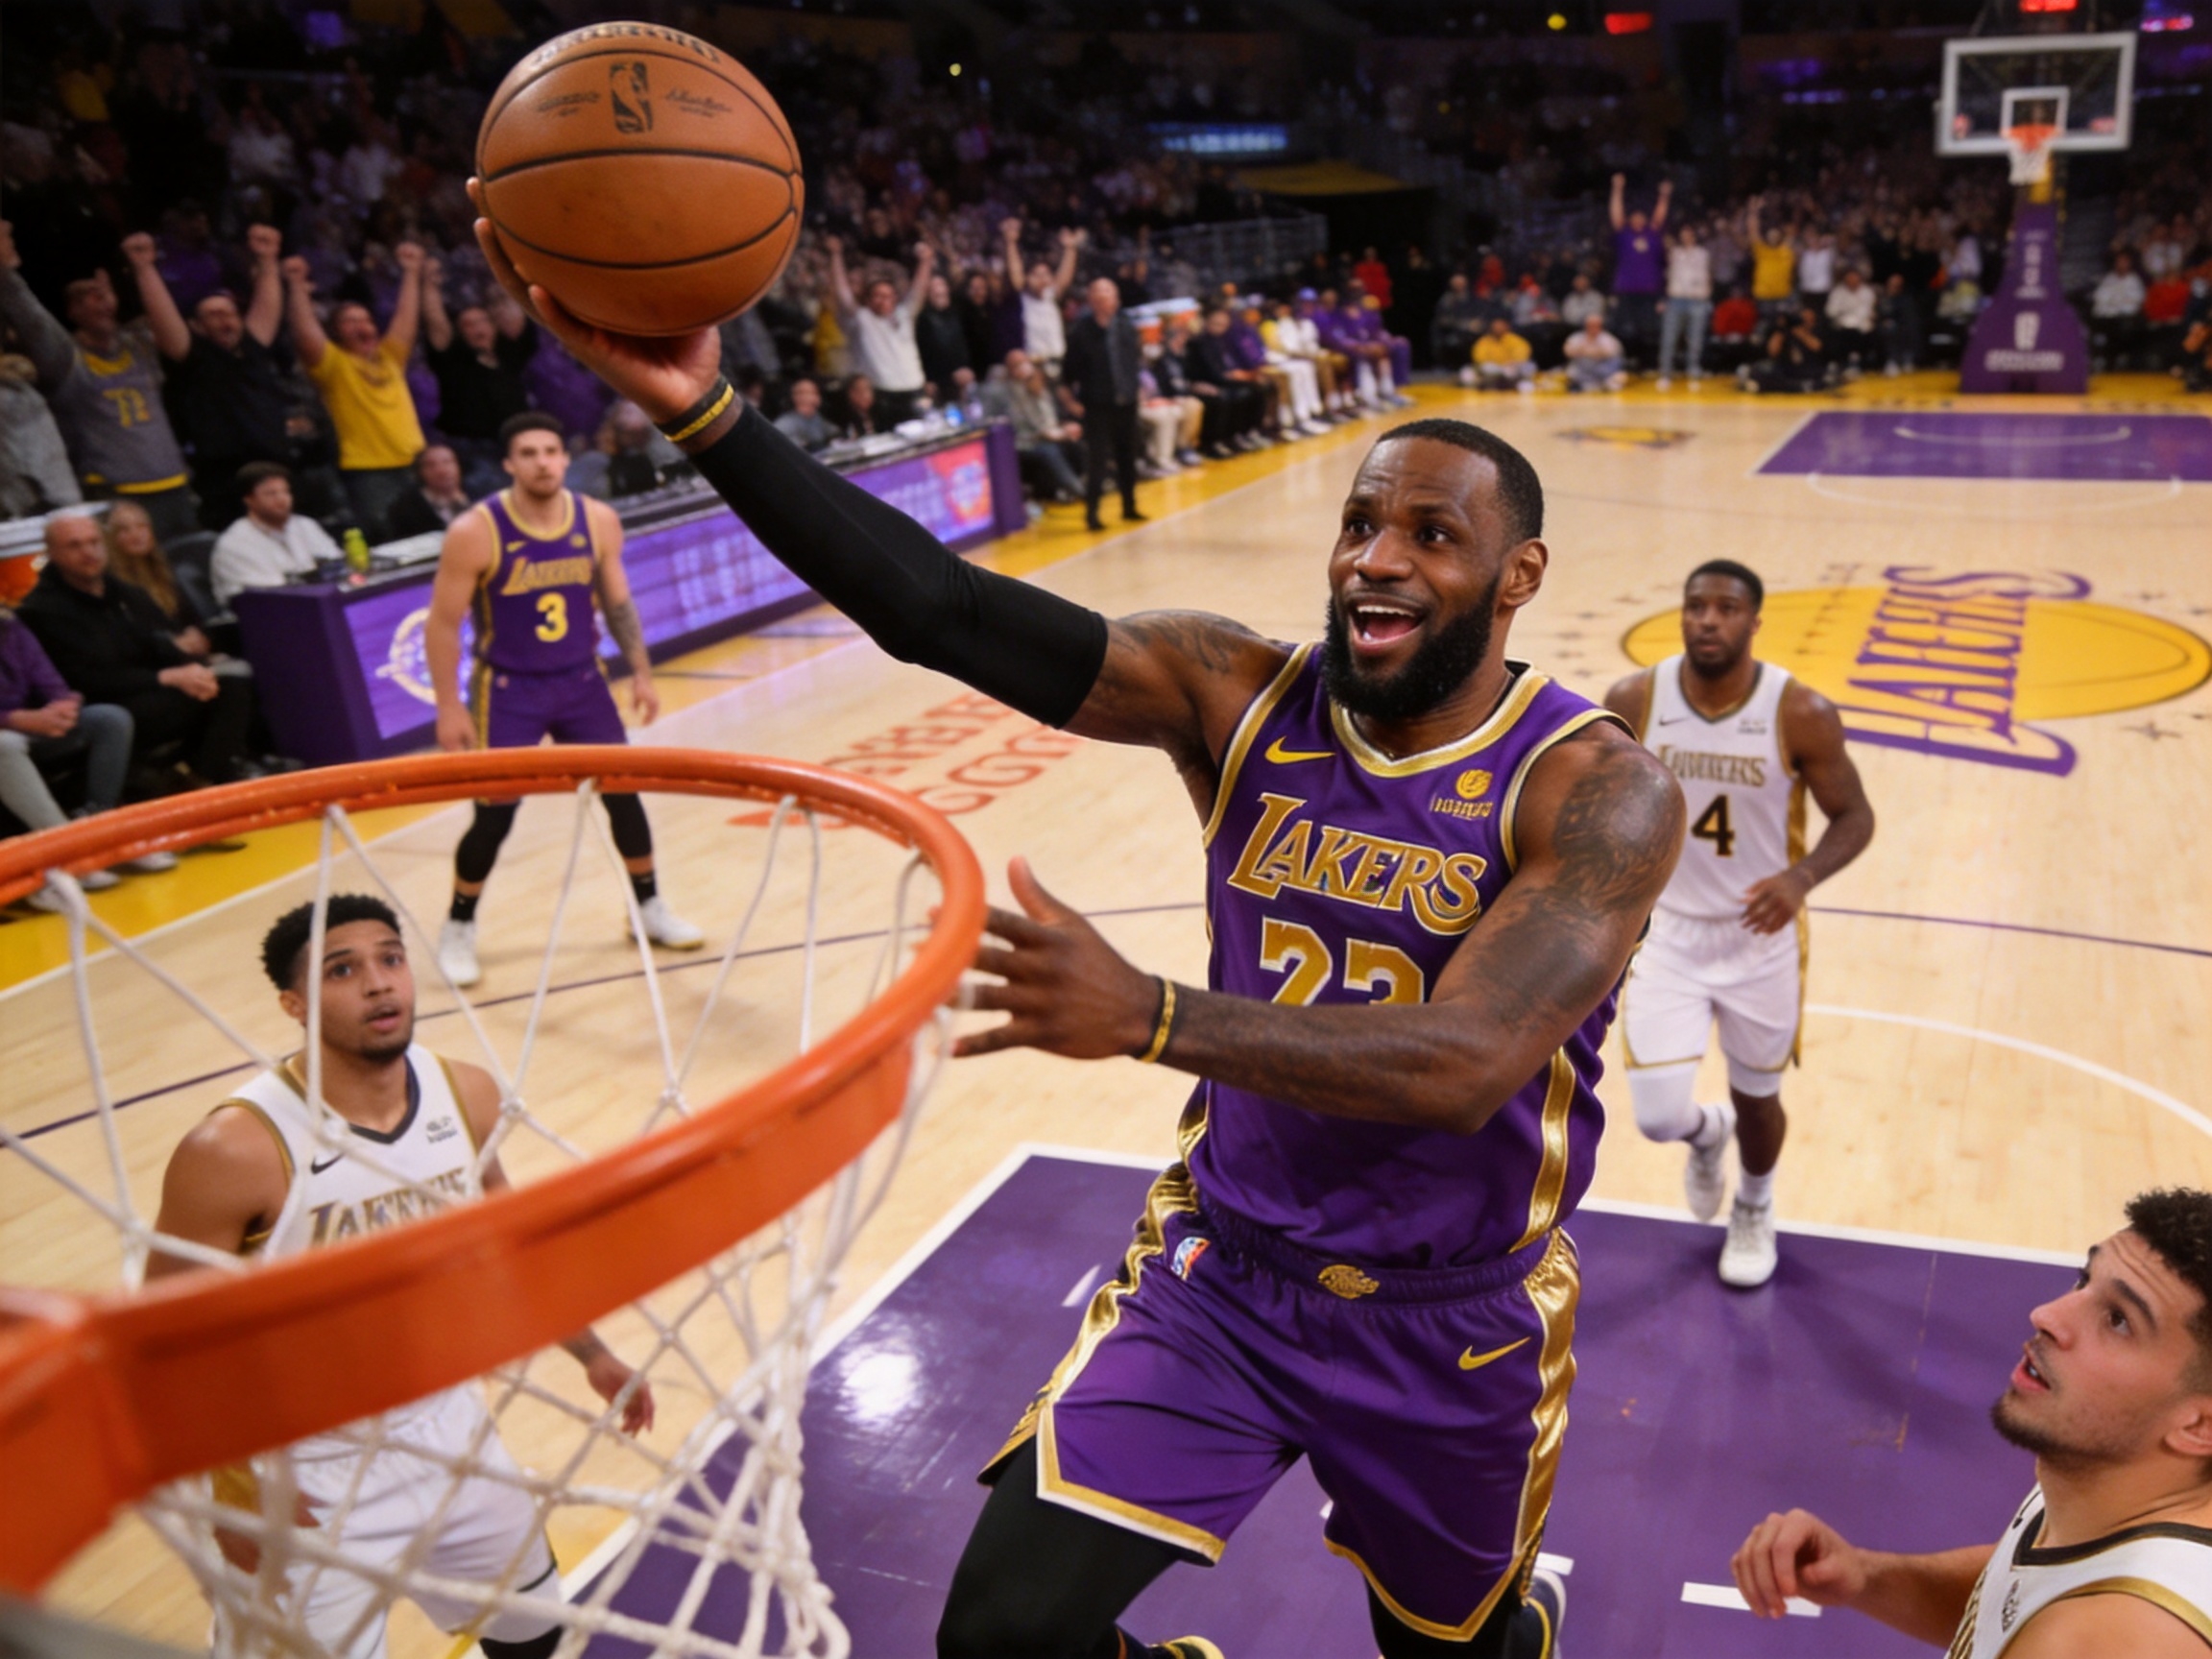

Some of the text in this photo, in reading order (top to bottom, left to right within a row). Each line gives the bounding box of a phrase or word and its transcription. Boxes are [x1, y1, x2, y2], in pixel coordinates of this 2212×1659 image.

[535, 591, 568, 642] 3
[1691, 794, 1735, 856] 4
[1227, 792, 1488, 936] LAKERS
